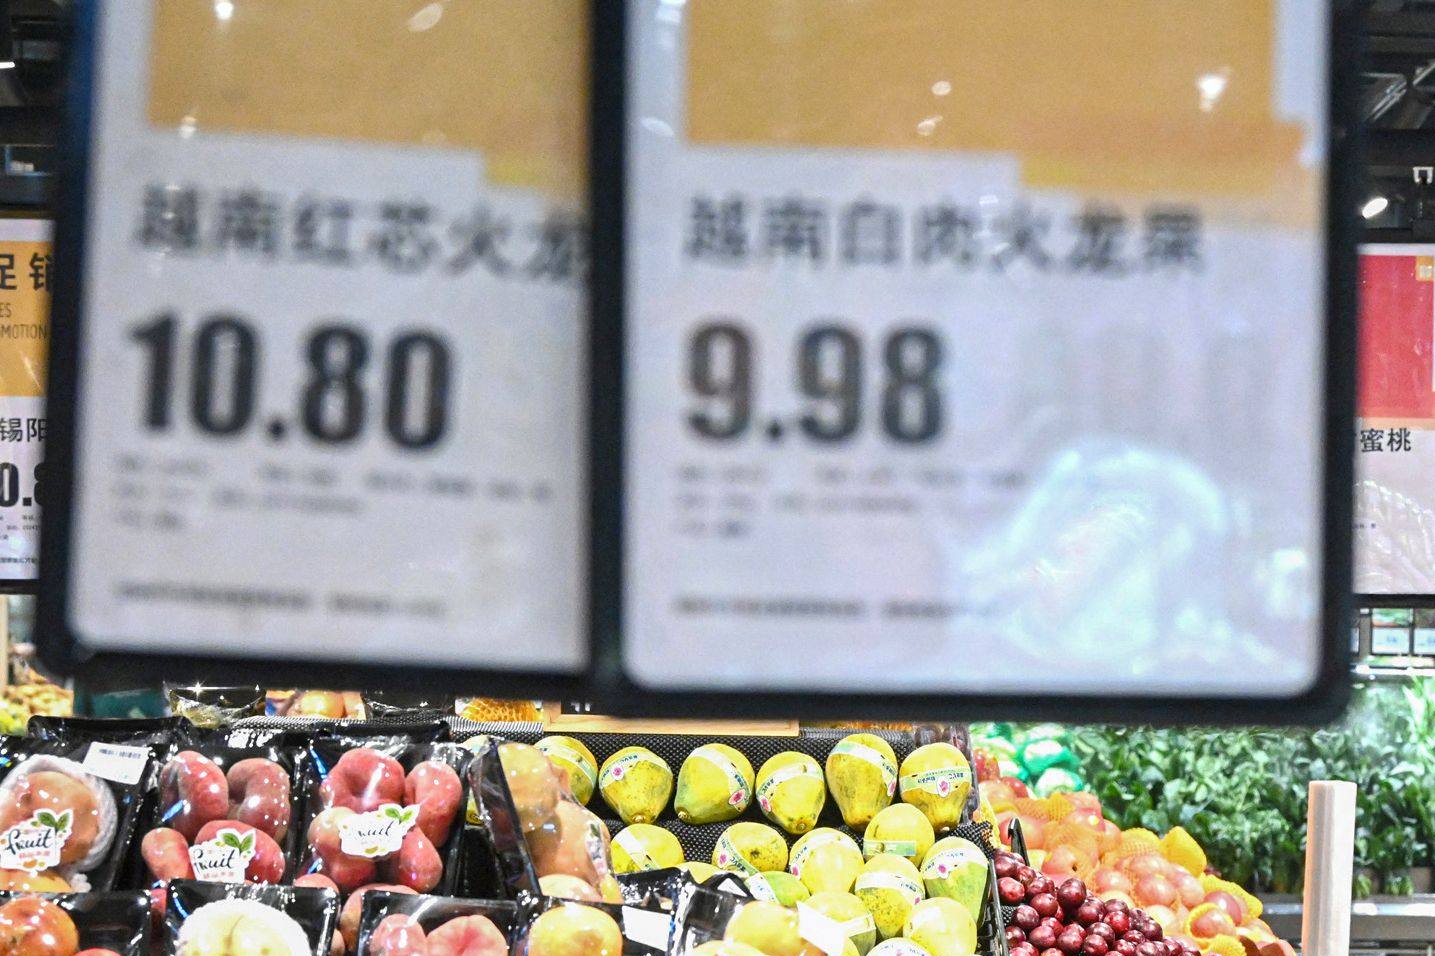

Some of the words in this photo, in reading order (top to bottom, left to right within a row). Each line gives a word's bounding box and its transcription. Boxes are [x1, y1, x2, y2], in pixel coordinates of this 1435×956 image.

[128, 308, 455, 454] 10.80
[685, 320, 948, 447] 9.98
[1355, 428, 1411, 454] 蜜桃
